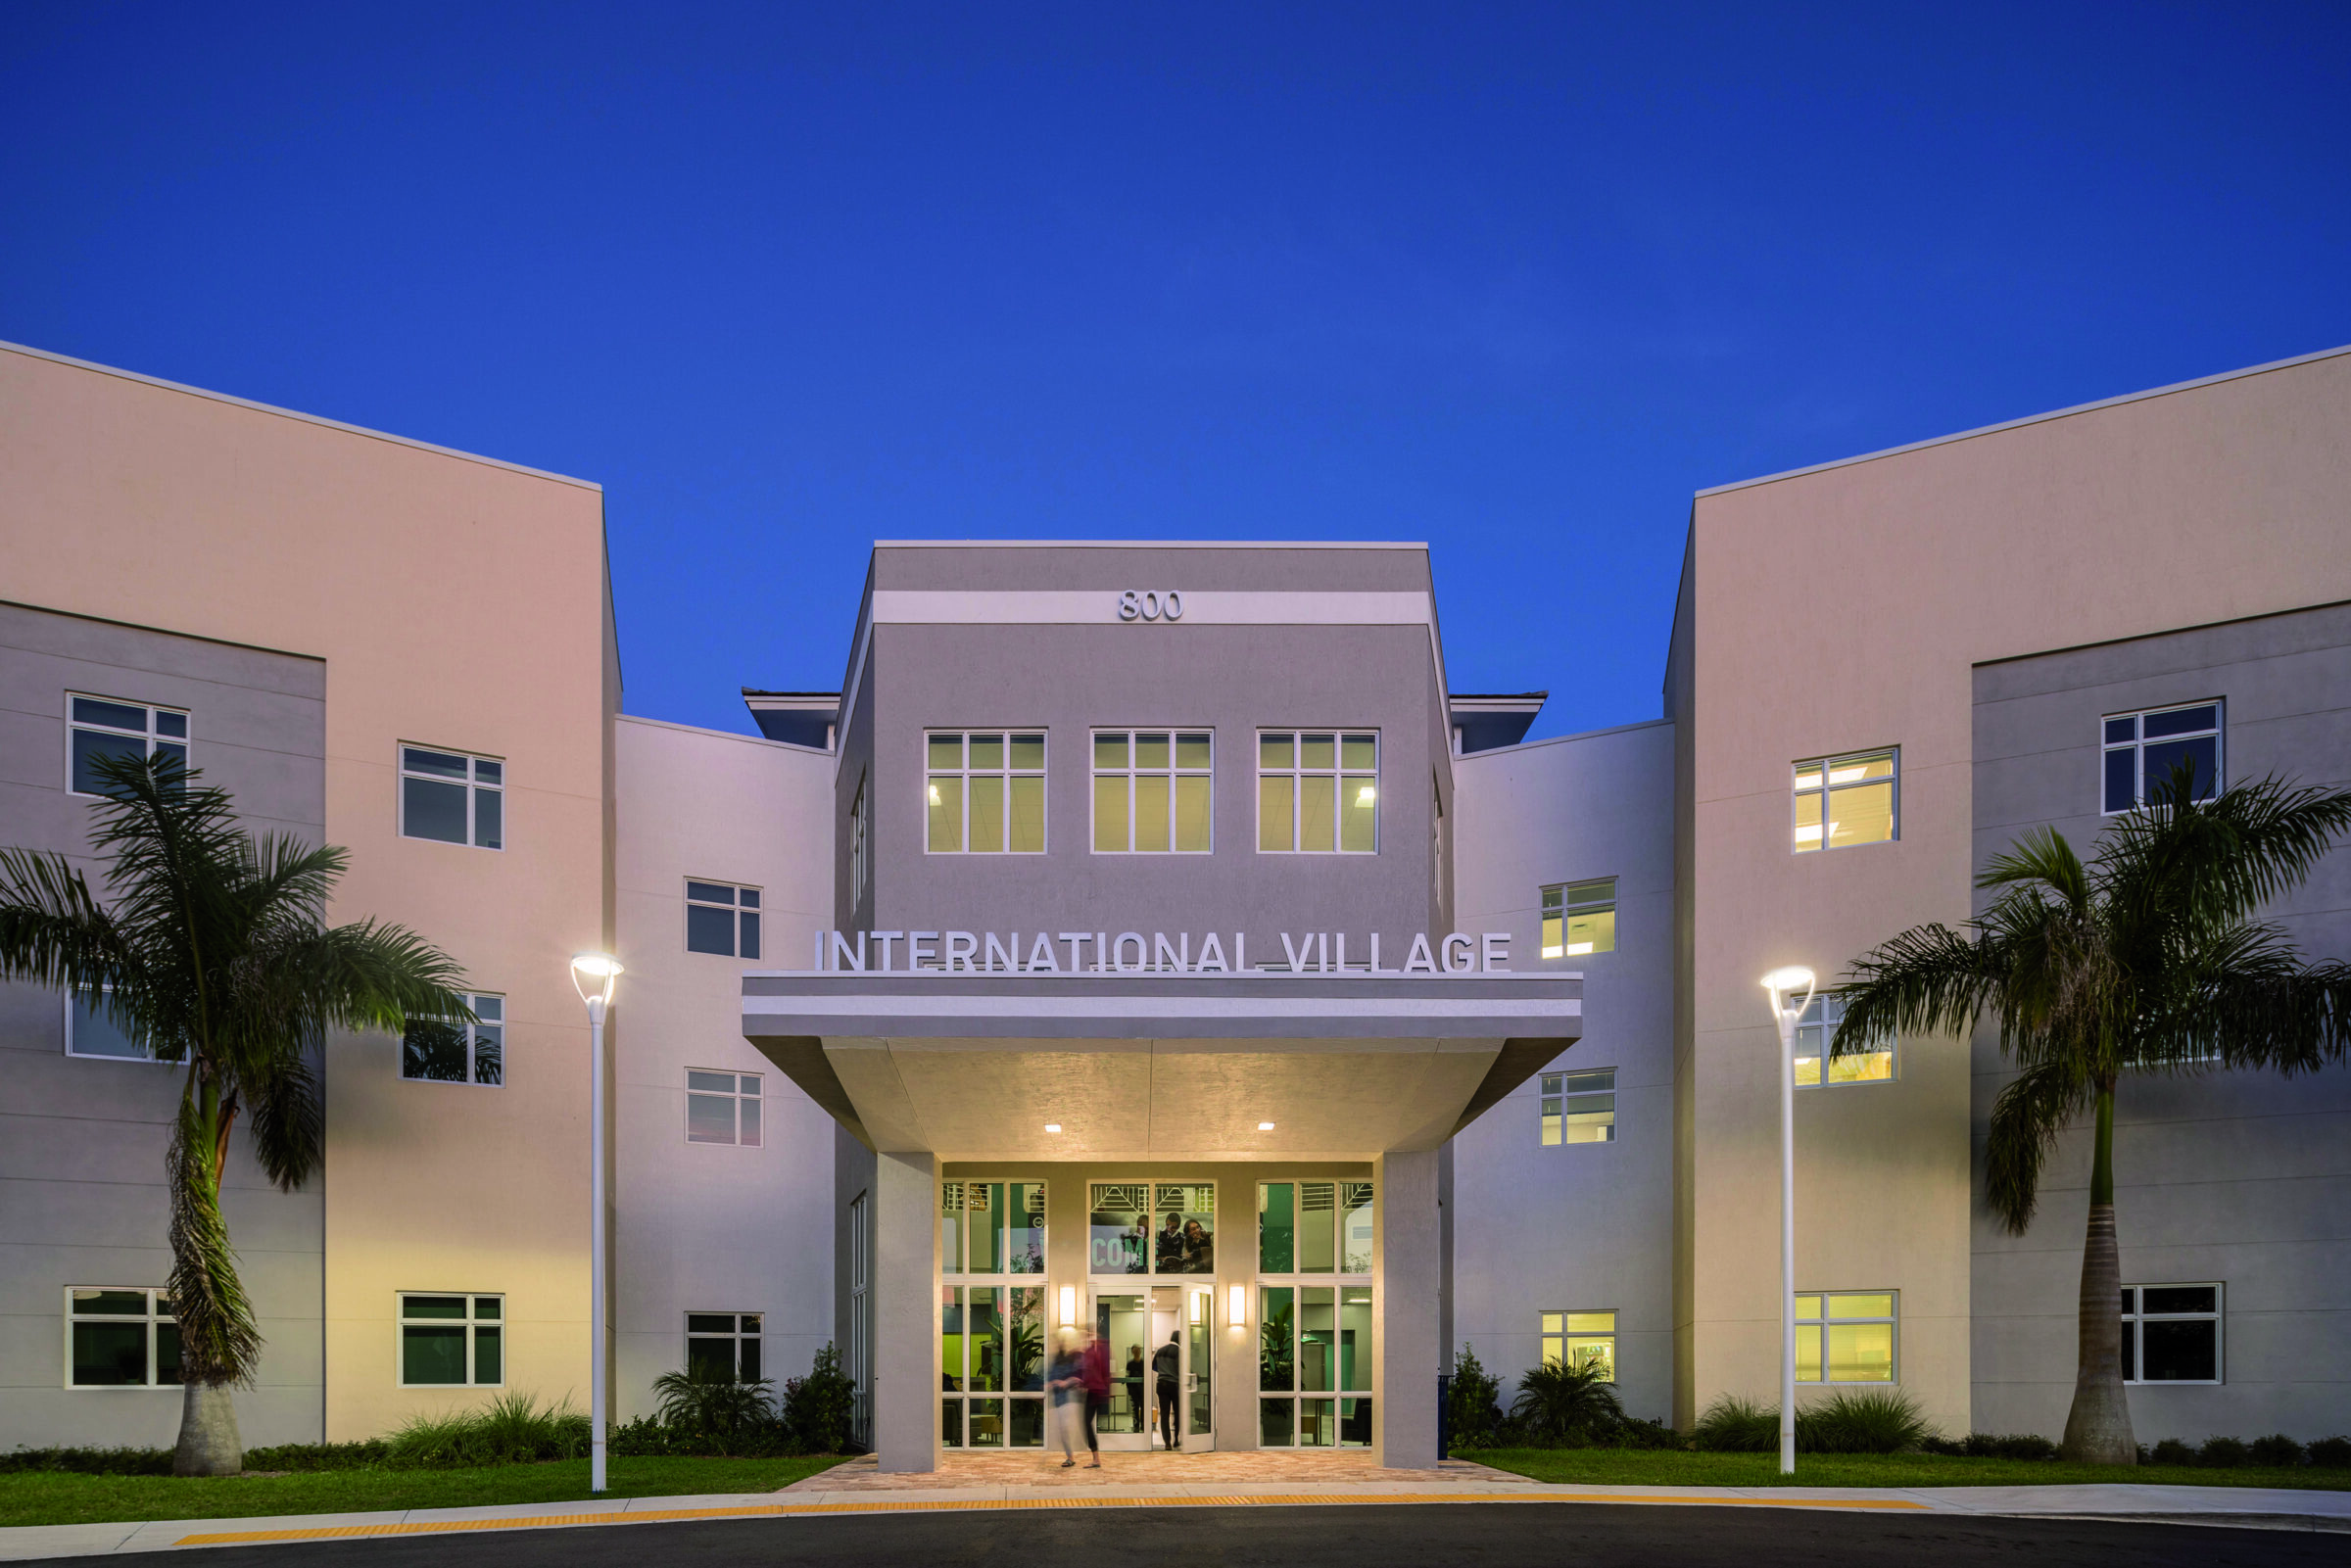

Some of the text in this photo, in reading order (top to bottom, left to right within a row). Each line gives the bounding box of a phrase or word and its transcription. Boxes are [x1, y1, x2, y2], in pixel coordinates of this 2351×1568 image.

[1120, 590, 1184, 621] 800
[815, 930, 1511, 973] INTERNATIONAL VILLAGE
